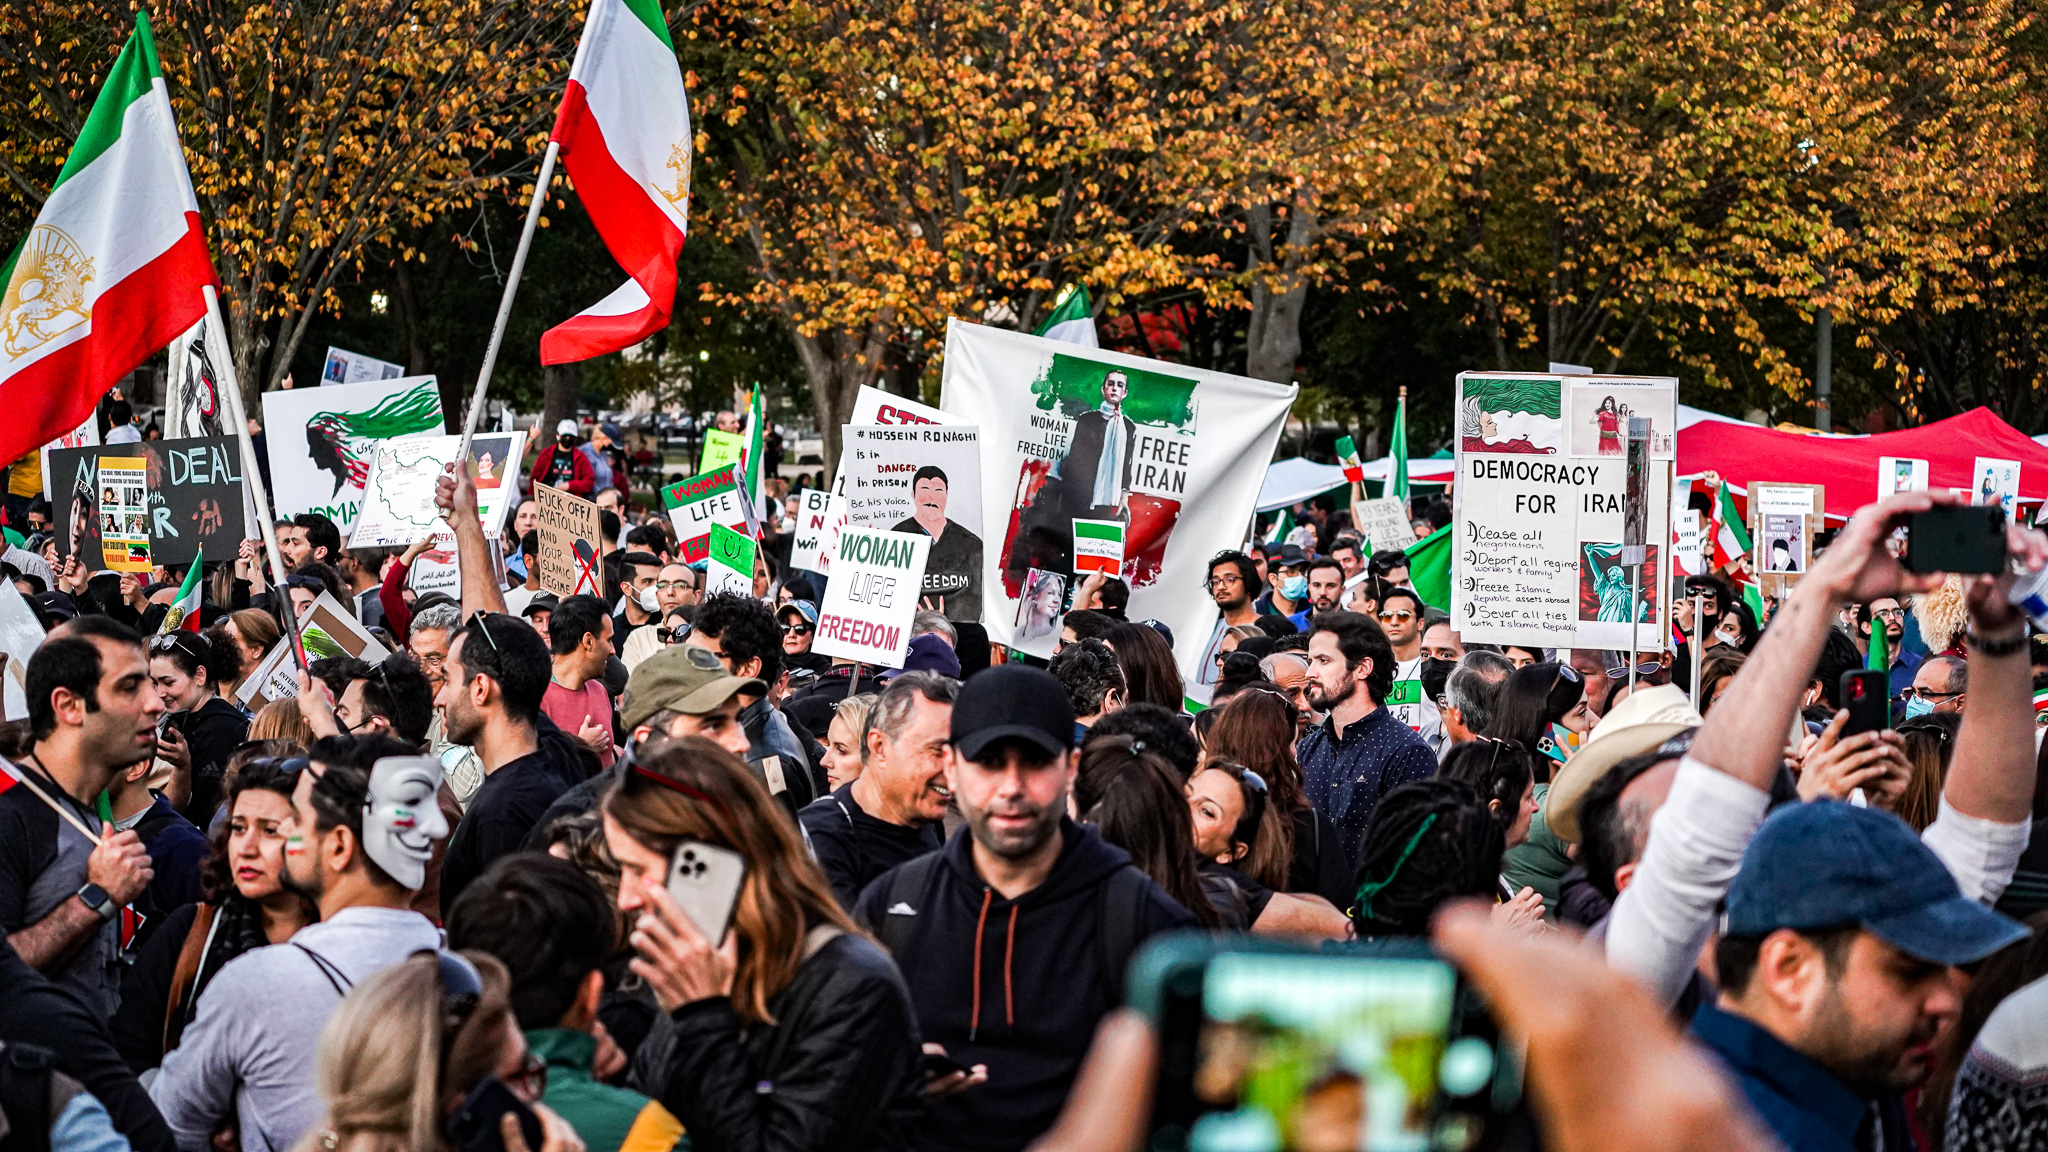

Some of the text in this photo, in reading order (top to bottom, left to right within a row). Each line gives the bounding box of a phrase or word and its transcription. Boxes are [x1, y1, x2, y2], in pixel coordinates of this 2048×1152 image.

[1031, 415, 1069, 434] WOMAN
[869, 431, 917, 441] HOSSEIN
[924, 431, 976, 442] RONAGHI
[1044, 432, 1067, 448] LIFE
[856, 449, 880, 459] is in
[1017, 440, 1064, 461] FREEDOM
[1140, 436, 1190, 466] FREE
[75, 443, 242, 487] N DEAL
[877, 464, 917, 473] DANGER
[1473, 459, 1599, 485] DEMOCRACY
[671, 469, 734, 502] WOMAN
[857, 477, 868, 487] in
[872, 479, 908, 488] PRISON
[1135, 463, 1187, 494] IRAN
[147, 490, 165, 504] ith
[538, 489, 591, 522] FUCK OFF!
[851, 499, 864, 508] Be
[867, 498, 882, 506] his
[1516, 494, 1556, 514] FOR
[690, 496, 731, 522] LIFE
[852, 510, 906, 522] Save his life
[538, 506, 594, 541] AYATOLLAH
[1478, 525, 1517, 540] Cease
[1522, 530, 1542, 541] all
[540, 529, 557, 544] AND
[540, 543, 563, 562] YOUR
[840, 532, 915, 570] WOMAN
[1476, 541, 1544, 552] negotiations
[540, 559, 571, 579] ISLAMIC
[1478, 552, 1518, 568] Deport
[1520, 557, 1538, 567] all
[1543, 560, 1579, 573] regime
[921, 574, 969, 588] EEDOM
[1474, 566, 1513, 574] workers
[1525, 568, 1553, 580] family
[541, 572, 570, 594] REGIME
[848, 572, 896, 608] LIFE
[1475, 578, 1510, 592] Freeze
[1515, 583, 1551, 594] Islamic
[1474, 594, 1511, 604] Republic
[1478, 605, 1519, 619] Sever
[1522, 611, 1540, 619] all
[1545, 611, 1567, 621] ties
[818, 614, 900, 651] FREEDOM
[1471, 620, 1578, 633] with Islamic Republic
